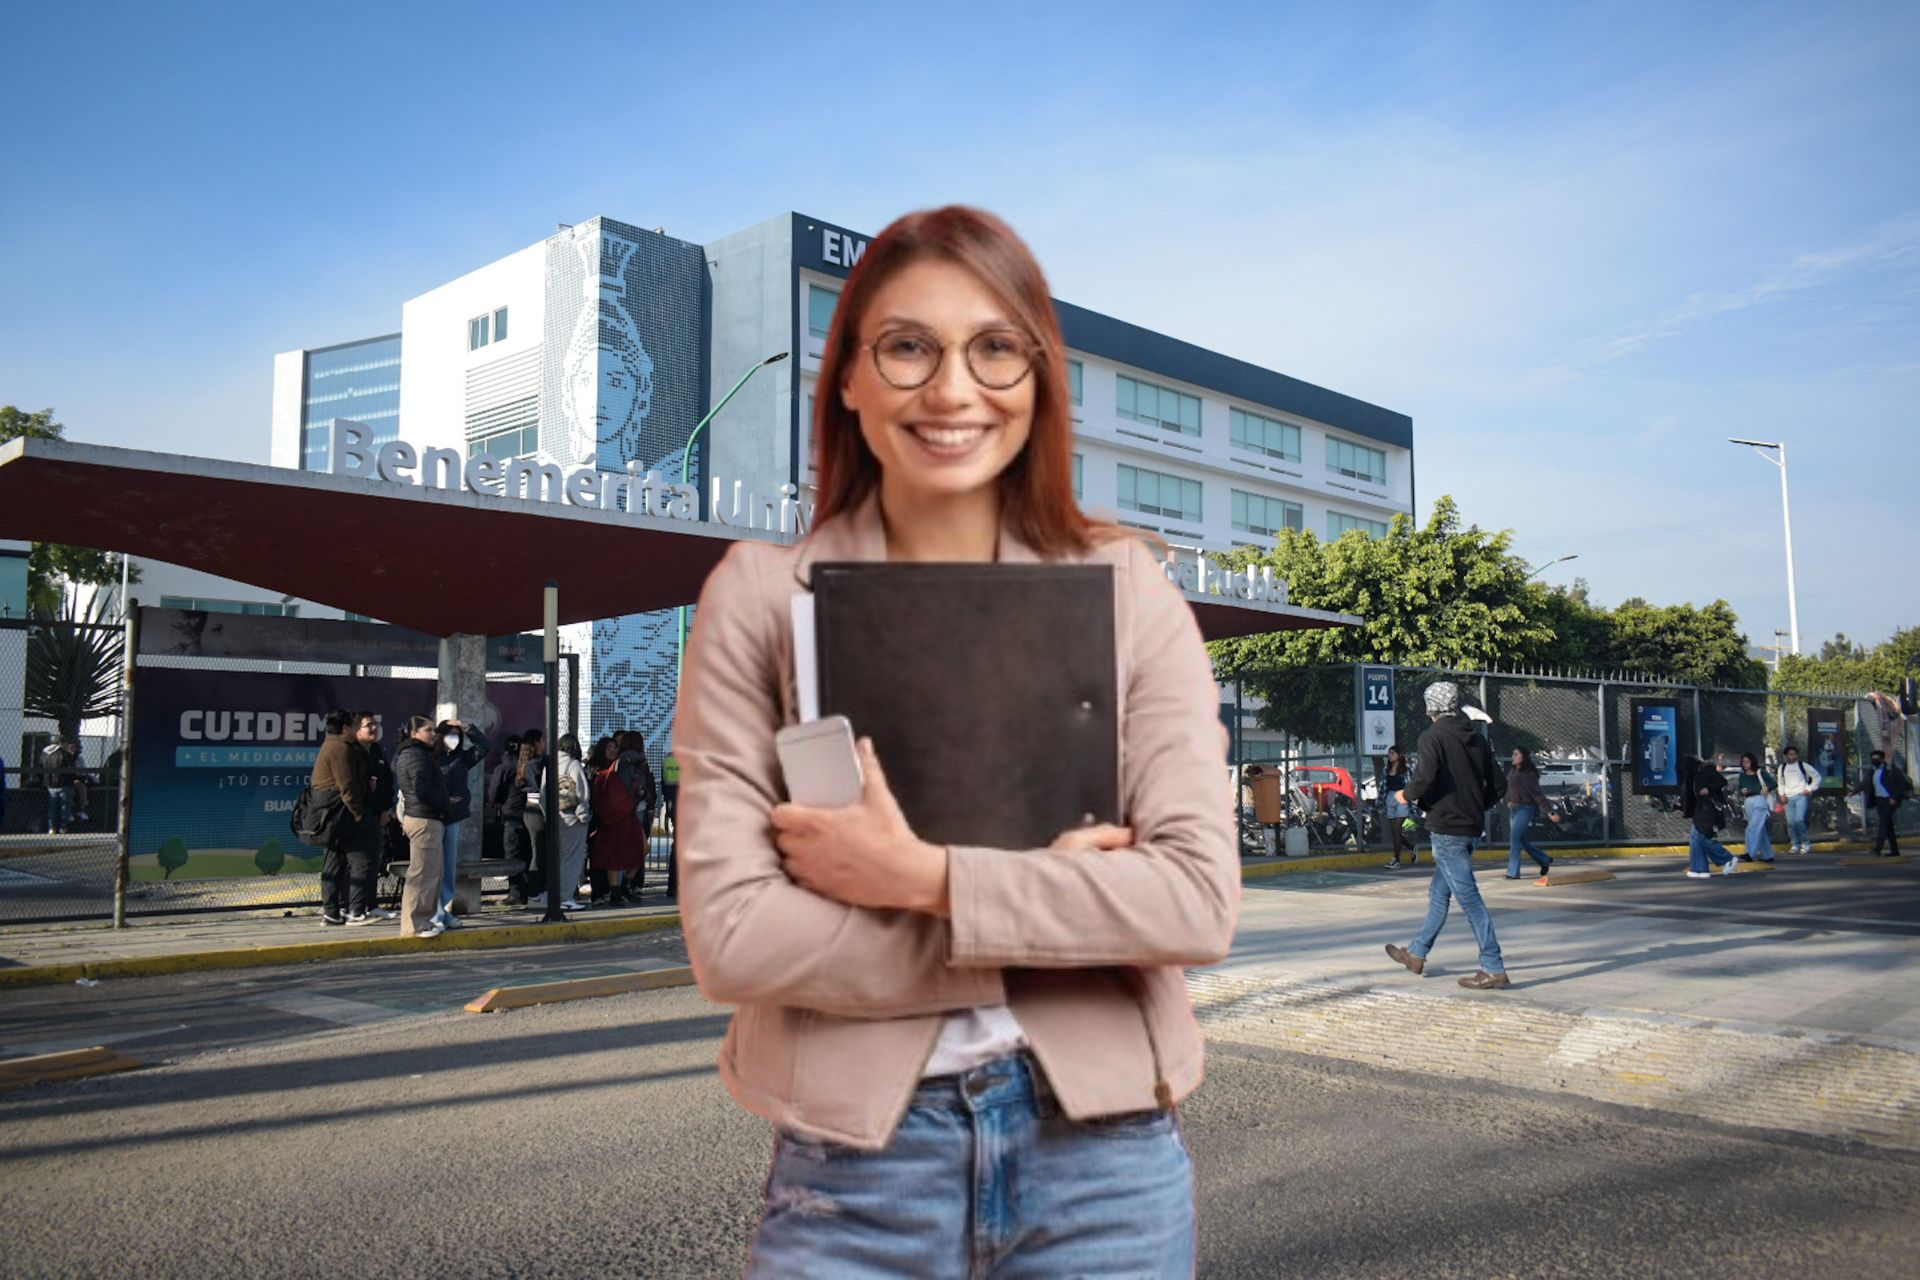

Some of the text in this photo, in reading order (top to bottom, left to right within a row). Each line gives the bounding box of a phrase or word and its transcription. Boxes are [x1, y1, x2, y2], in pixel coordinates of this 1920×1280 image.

[330, 418, 699, 520] Benemérita
[1368, 685, 1389, 705] 14
[200, 752, 219, 763] EL
[264, 800, 298, 812] BUA
